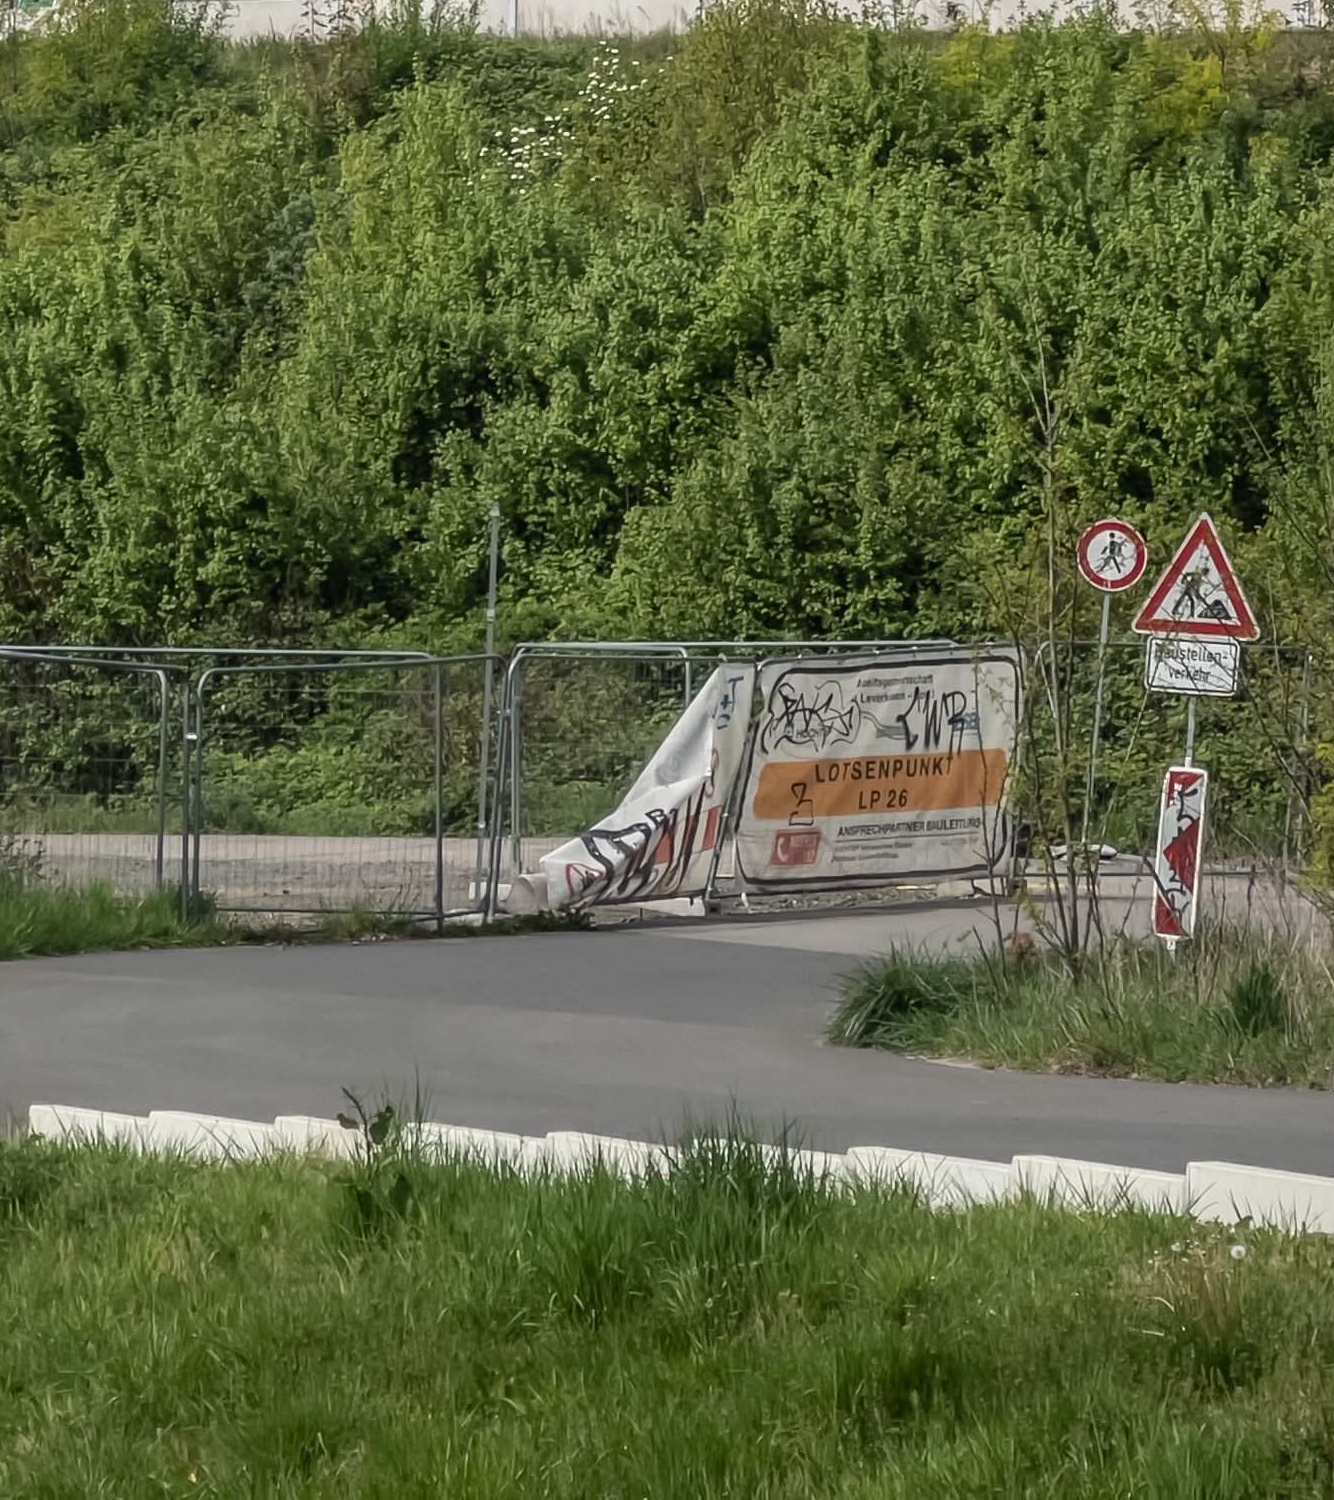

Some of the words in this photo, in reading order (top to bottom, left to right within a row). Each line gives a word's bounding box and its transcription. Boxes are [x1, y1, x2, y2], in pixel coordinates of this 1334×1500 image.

[814, 756, 954, 783] LOTSENPUNKT
[858, 791, 881, 810] LP
[886, 789, 909, 808] 26
